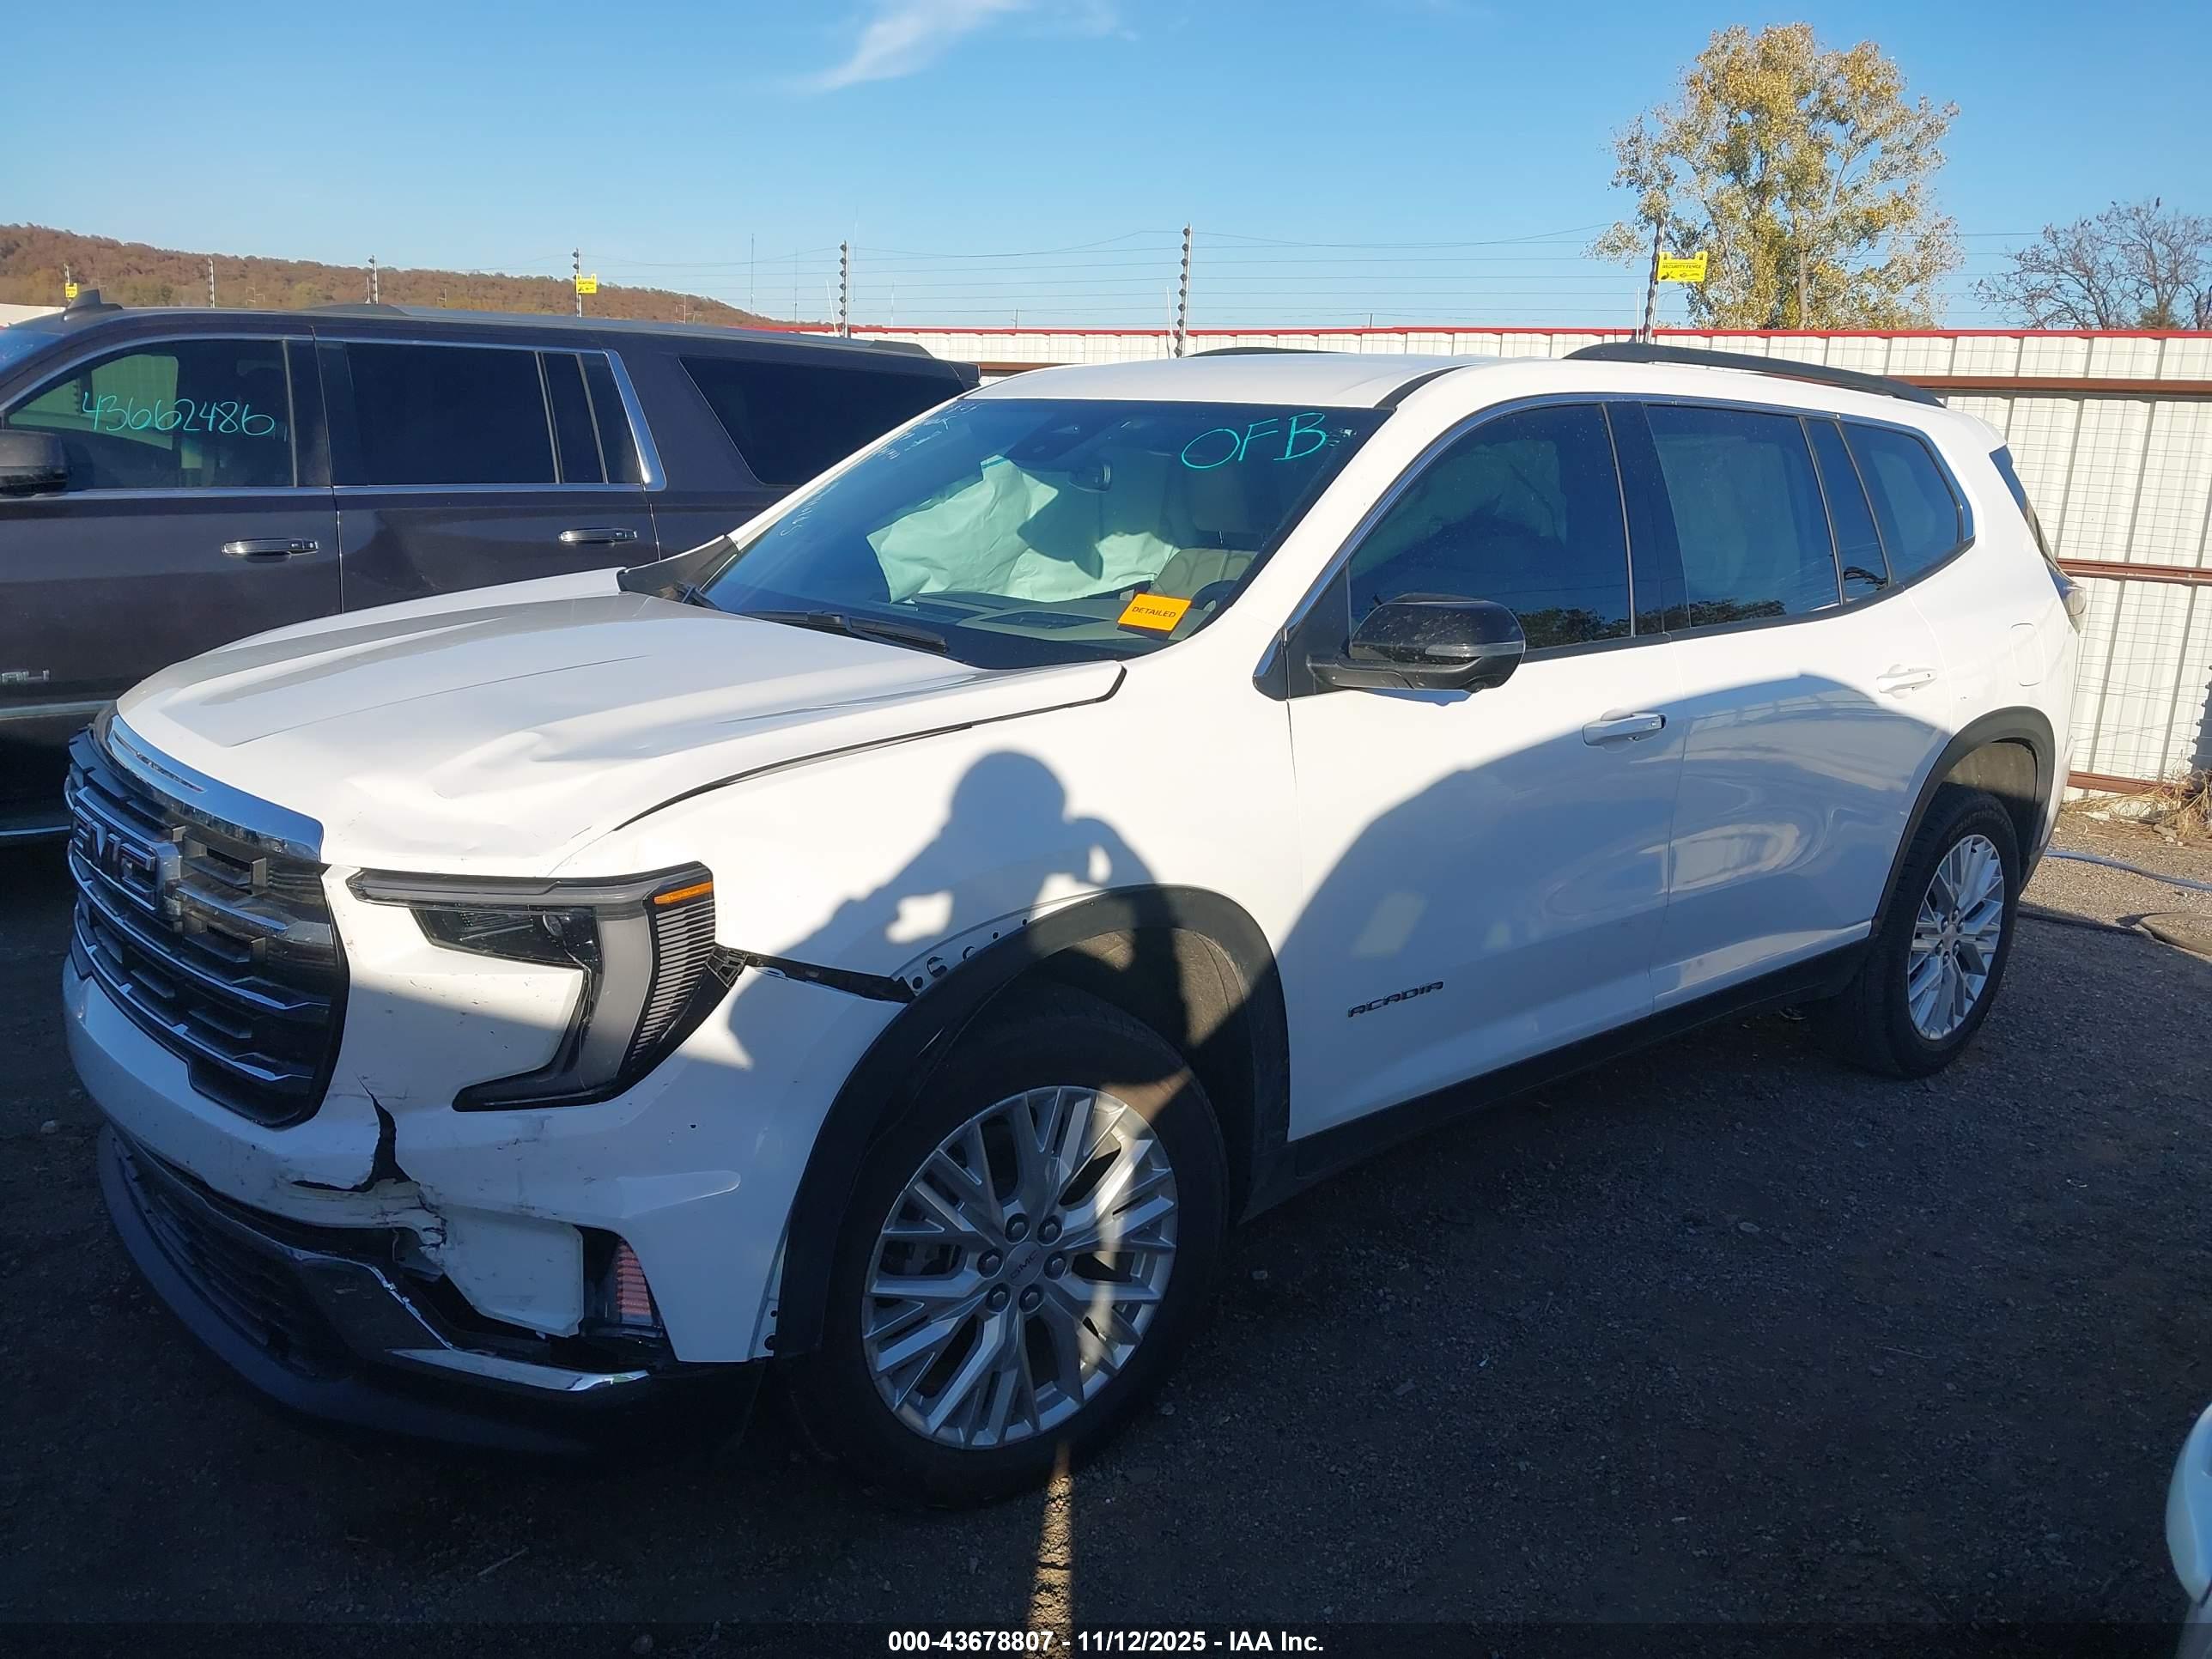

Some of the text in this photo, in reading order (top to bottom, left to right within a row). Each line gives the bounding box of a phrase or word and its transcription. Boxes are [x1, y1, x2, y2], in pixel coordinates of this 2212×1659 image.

[82, 392, 276, 436] 43662486
[1132, 606, 1176, 617] DETAILED
[1347, 981, 1443, 1018] ACADIA
[1009, 1250, 1038, 1279] GMC
